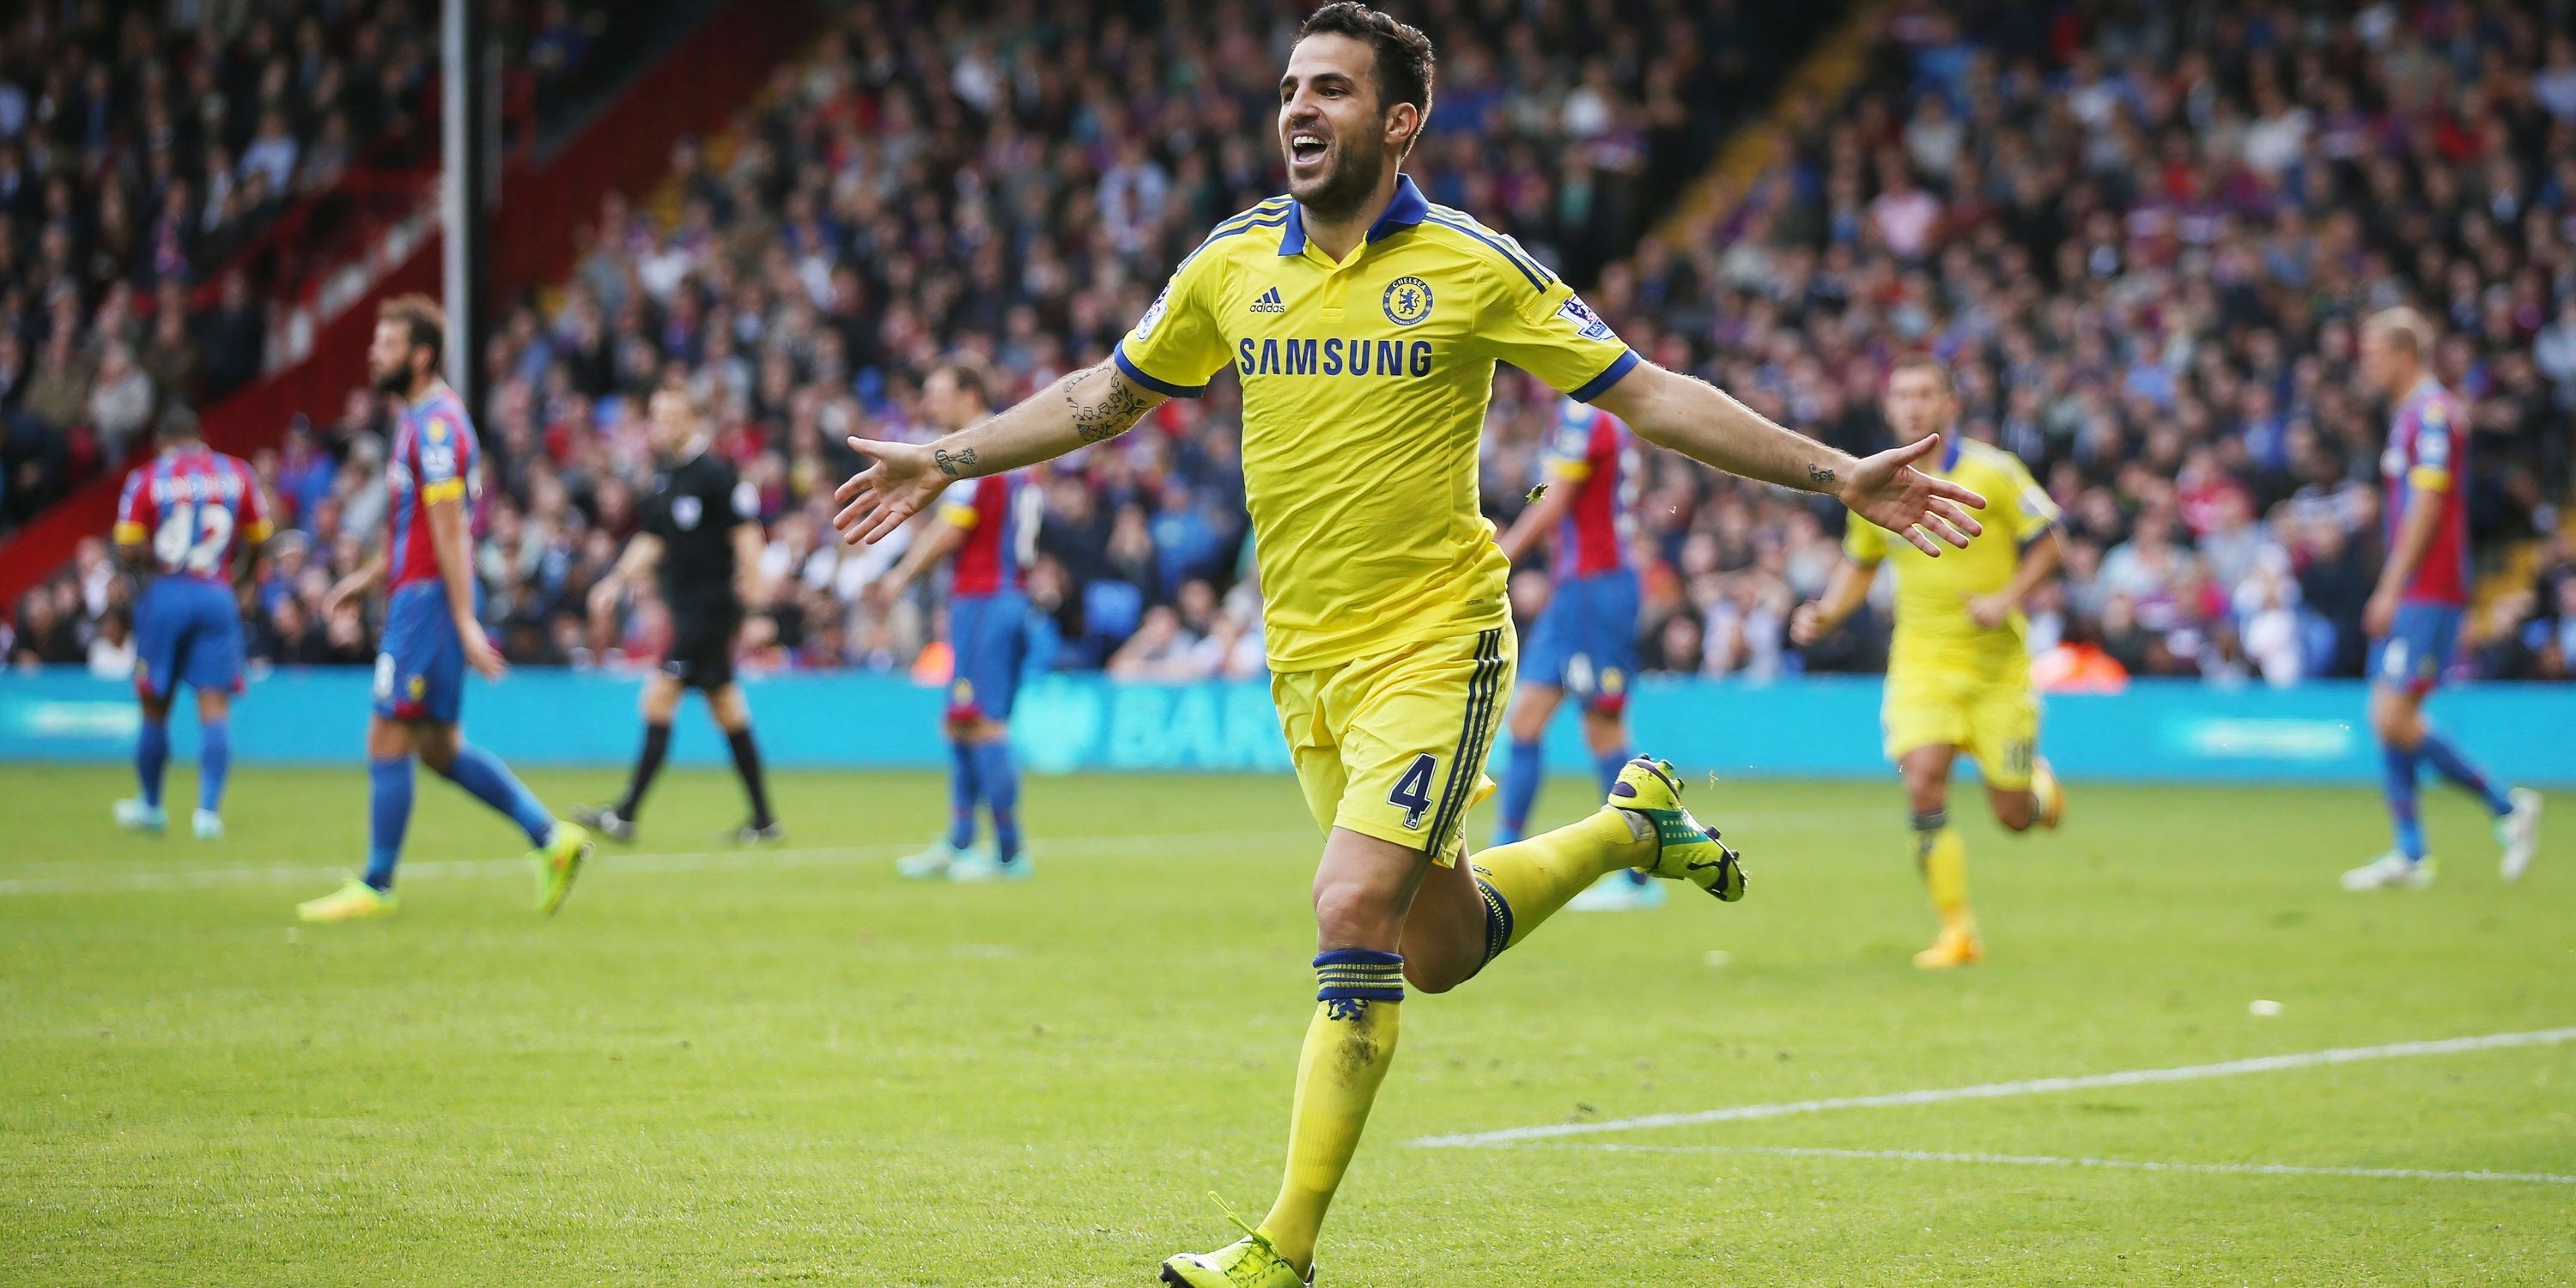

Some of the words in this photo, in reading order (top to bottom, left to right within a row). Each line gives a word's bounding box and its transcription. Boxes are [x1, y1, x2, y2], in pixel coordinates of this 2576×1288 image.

[1392, 277, 1426, 290] CHELSEA
[1249, 302, 1285, 313] adidas
[1239, 337, 1432, 377] SAMSUNG
[1387, 752, 1438, 830] 4
